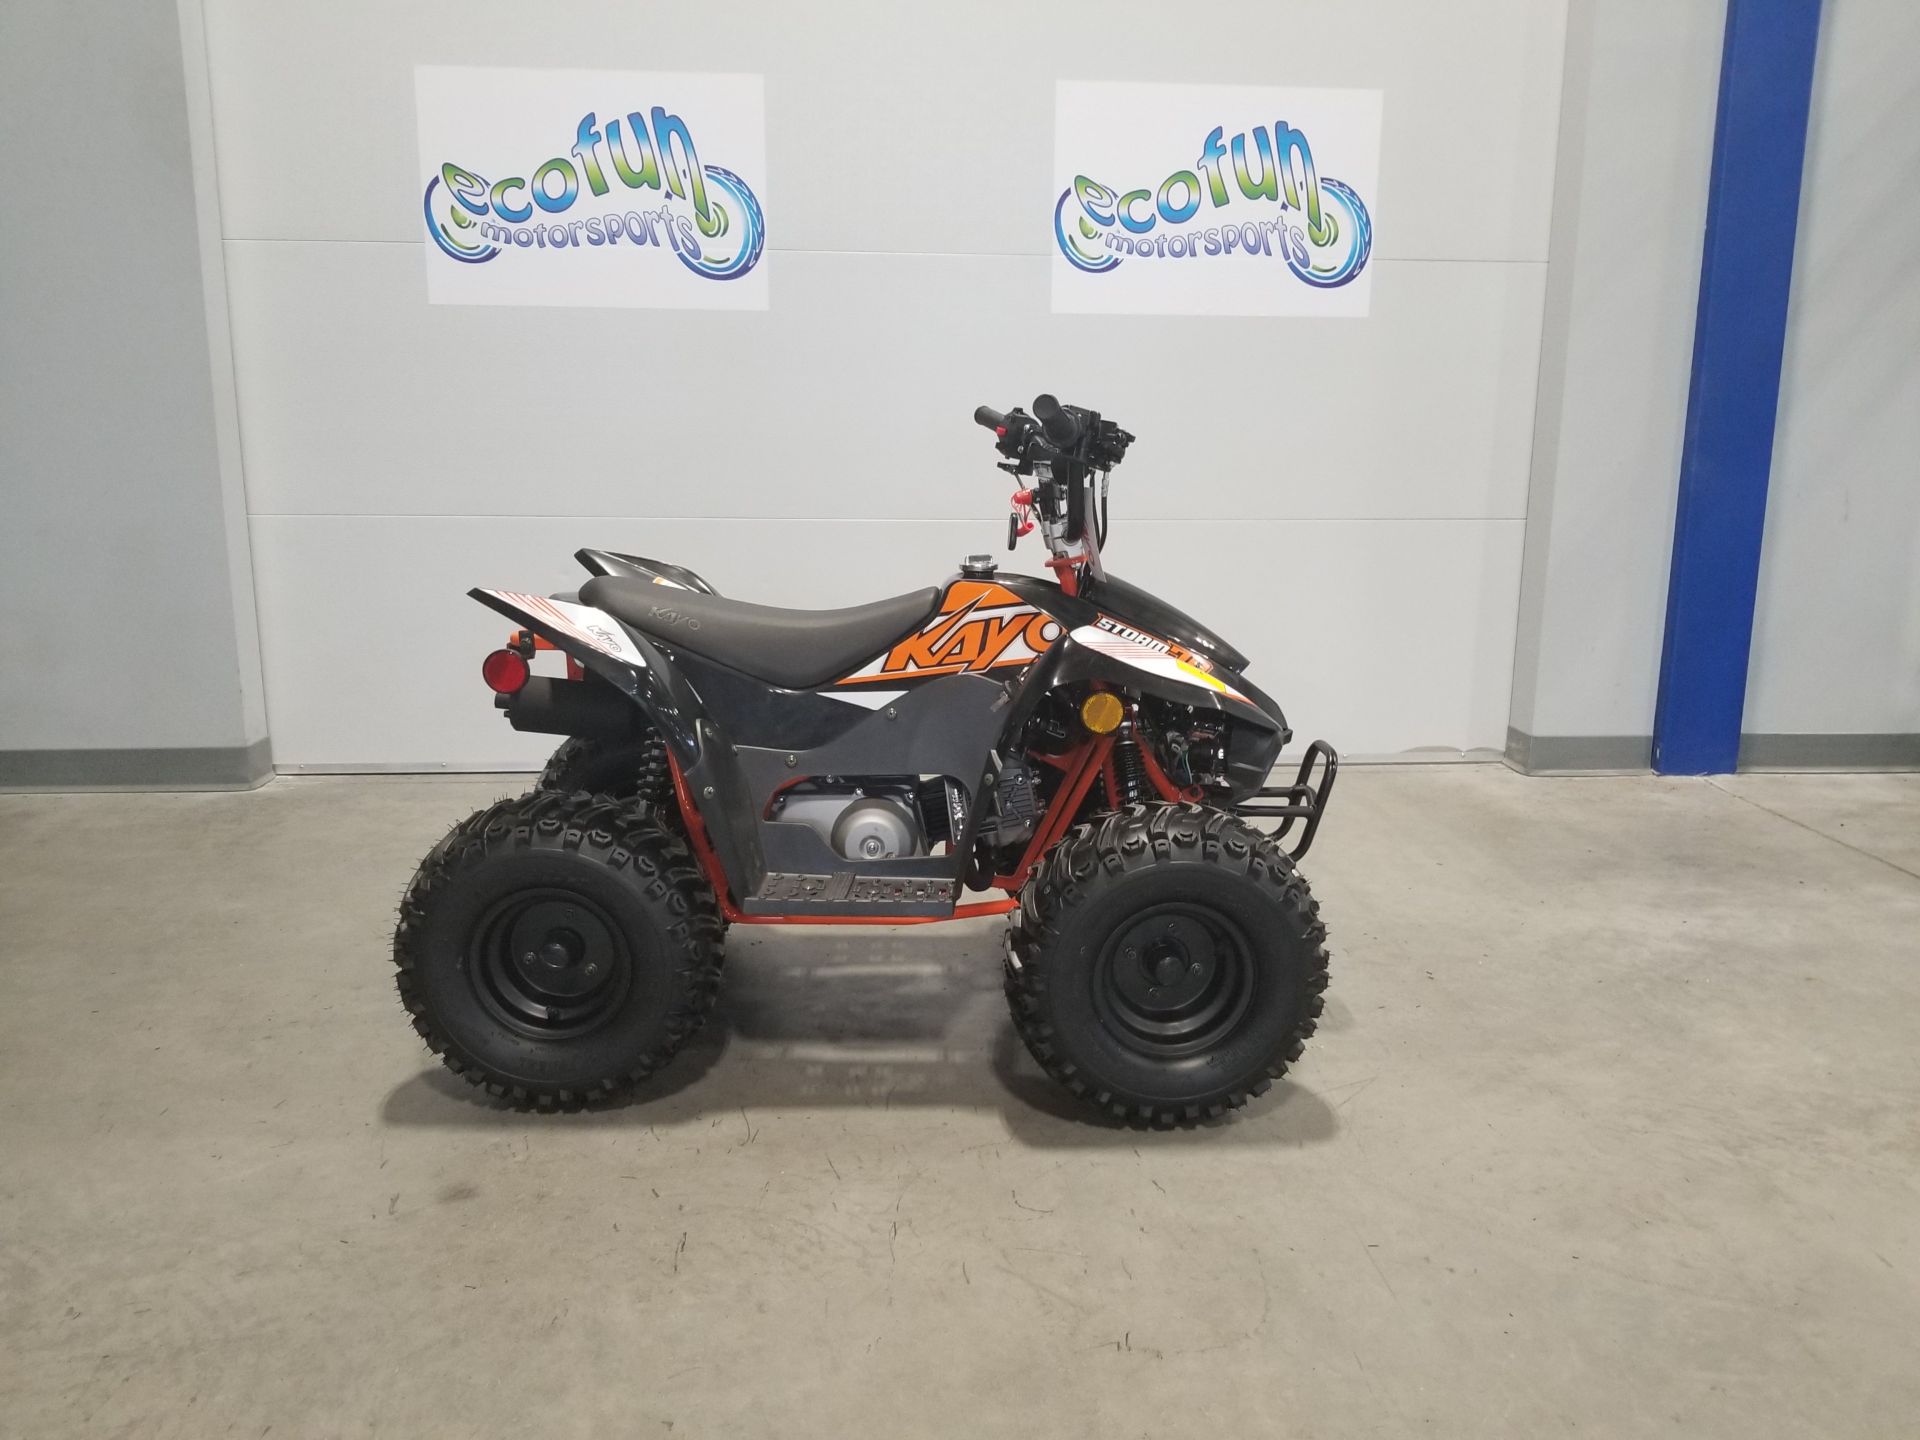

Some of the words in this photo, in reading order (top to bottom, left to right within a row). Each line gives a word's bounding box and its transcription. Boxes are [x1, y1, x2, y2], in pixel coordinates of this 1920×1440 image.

[442, 106, 711, 223] ecofun
[1074, 120, 1321, 233] ecofun
[481, 204, 702, 261] motorsports
[1105, 216, 1310, 270] motorsports
[649, 606, 700, 631] KAYO
[881, 594, 1065, 673] KAYO
